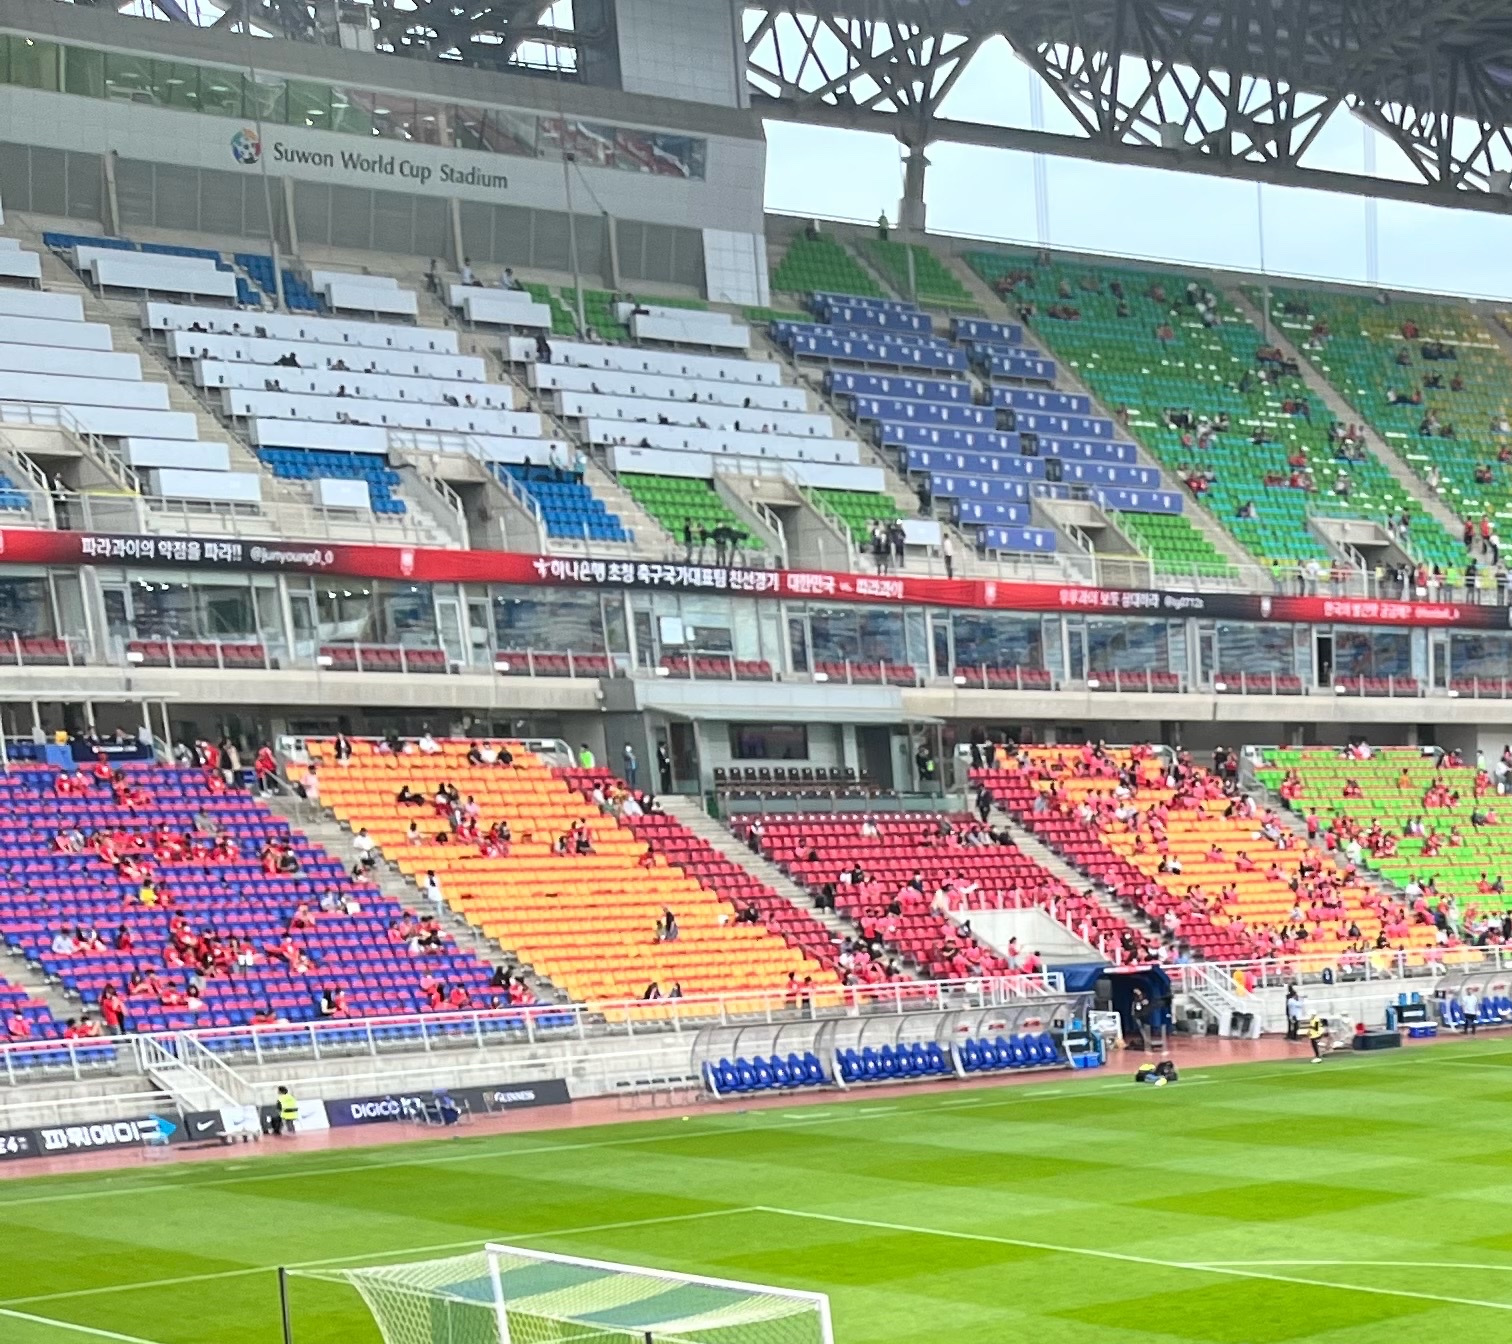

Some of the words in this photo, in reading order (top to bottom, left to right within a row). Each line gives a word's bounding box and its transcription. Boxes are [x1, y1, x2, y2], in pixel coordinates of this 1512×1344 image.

[273, 142, 334, 167] Suwon
[341, 151, 394, 175] World
[399, 160, 431, 185] Cup
[440, 164, 508, 189] Stadium
[82, 537, 154, 559] 파라과이의
[350, 1097, 400, 1119] DIGICO
